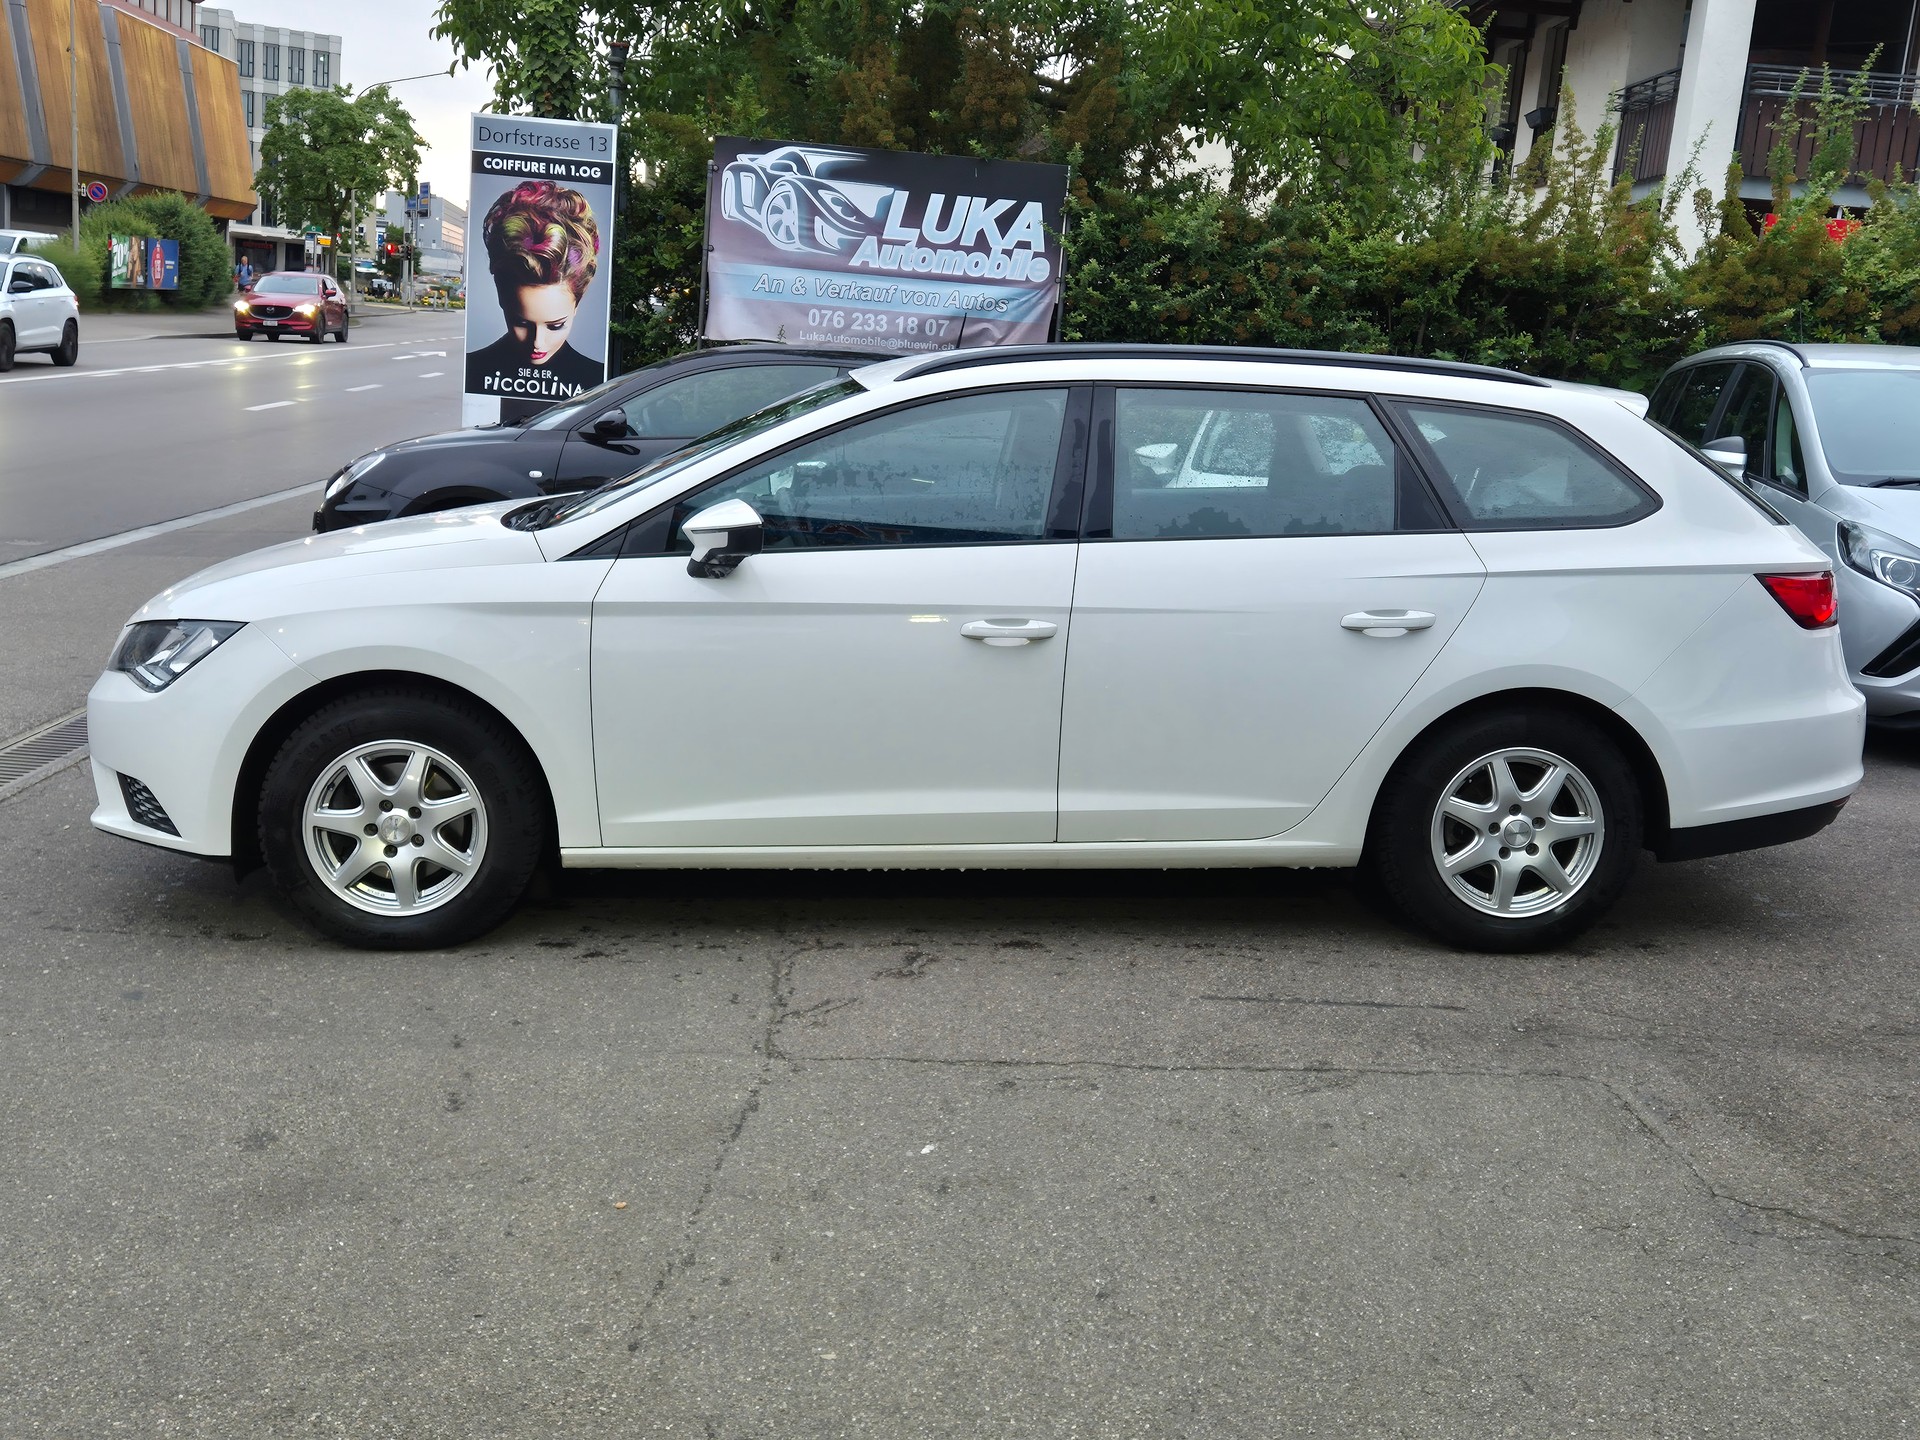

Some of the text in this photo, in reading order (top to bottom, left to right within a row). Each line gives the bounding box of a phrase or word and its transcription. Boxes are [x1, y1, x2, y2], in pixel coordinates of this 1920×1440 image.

[479, 126, 608, 152] Dorfstrasse 13
[483, 157, 601, 178] COIFFURE IM 1.OG
[882, 190, 1045, 252] LUKA
[848, 235, 1051, 283] Automobile
[752, 273, 1009, 313] An & Verkauf von Autos
[808, 308, 950, 337] 076 233 18 07
[799, 330, 955, 351] LukaAutomobile@bluewin.ch
[518, 368, 552, 379] SIE & ER
